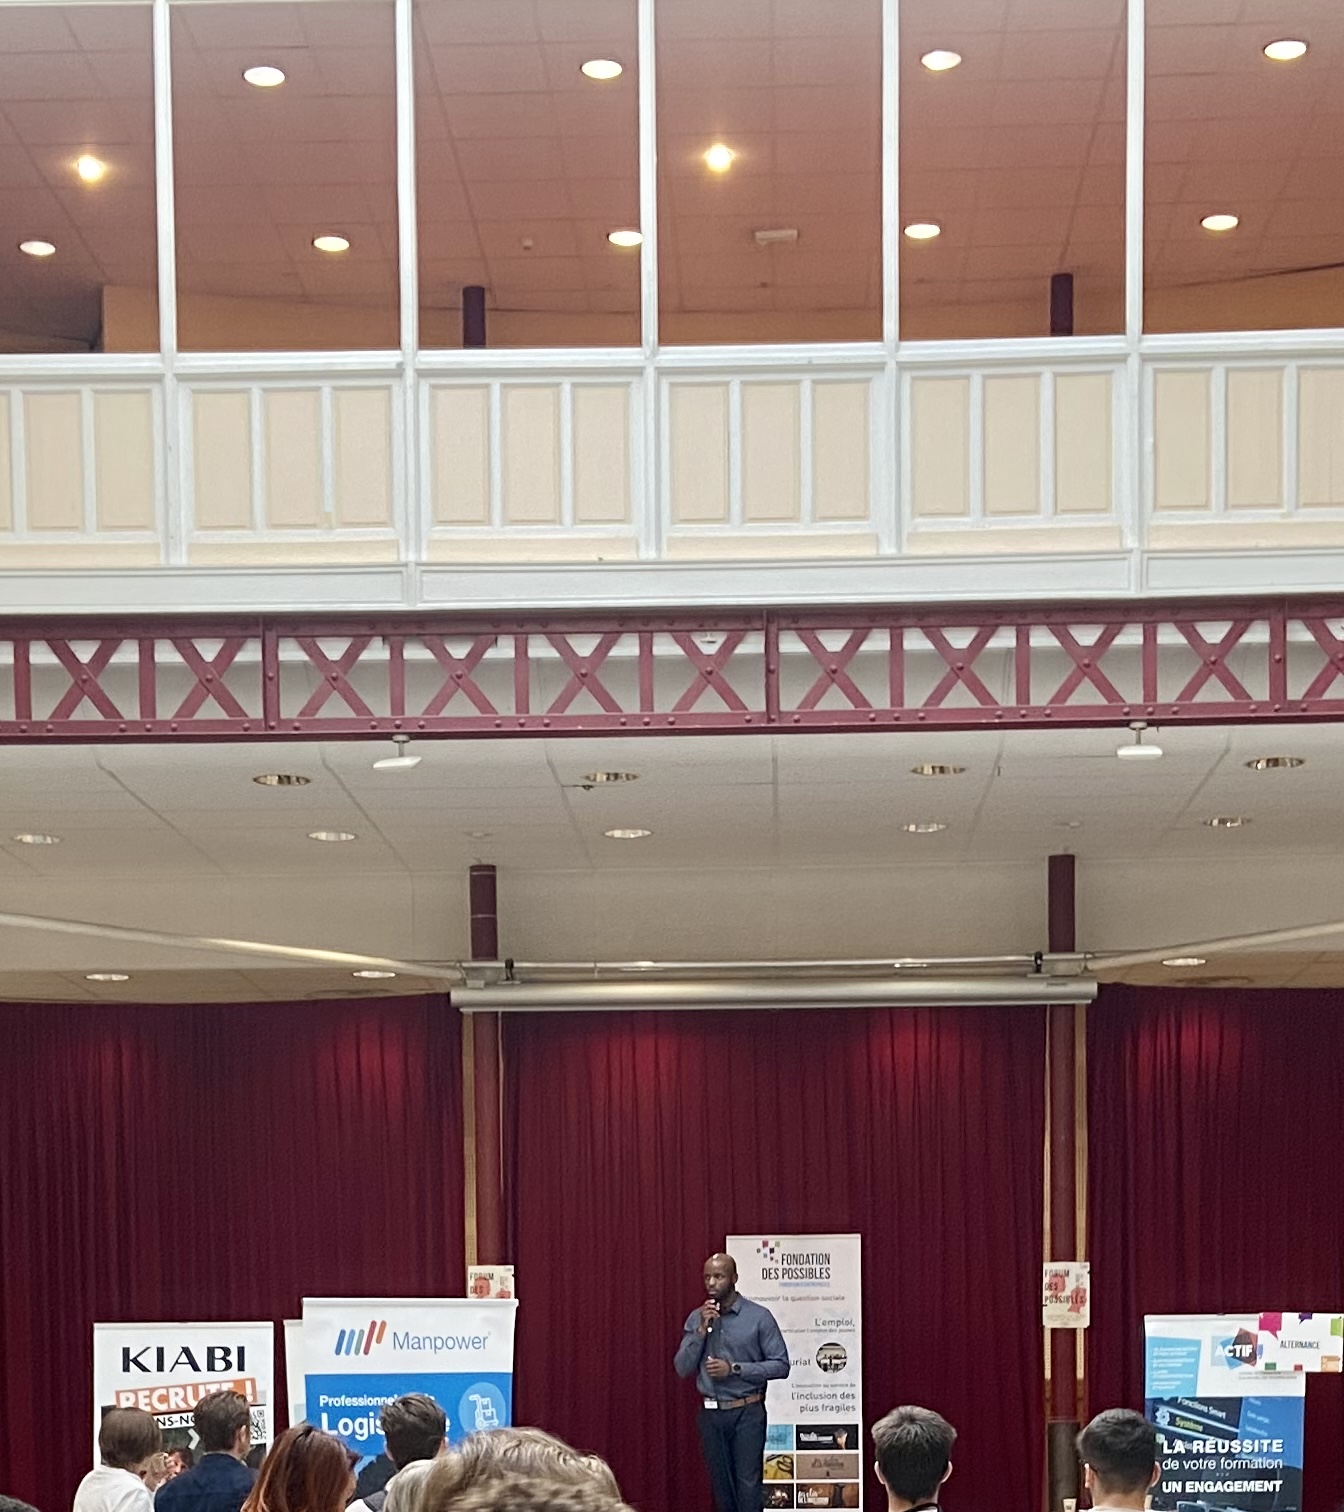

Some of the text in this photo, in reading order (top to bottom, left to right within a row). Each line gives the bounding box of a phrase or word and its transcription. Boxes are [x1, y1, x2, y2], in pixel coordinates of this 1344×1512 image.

[781, 1253, 831, 1266] FONDATION
[761, 1267, 831, 1280] DES POSSIBLES
[393, 1332, 490, 1354] Manpower
[1280, 1340, 1321, 1350] ALTERNANCE
[1215, 1344, 1253, 1358] ACTIF
[122, 1346, 246, 1373] KIABI
[791, 1392, 856, 1401] l'inclusion des
[800, 1404, 856, 1414] plus fragiles
[1162, 1437, 1284, 1454] LA RÉUSSITE
[1162, 1457, 1283, 1470] de votre formation
[1162, 1480, 1284, 1493] UN ENGAGEMENT
